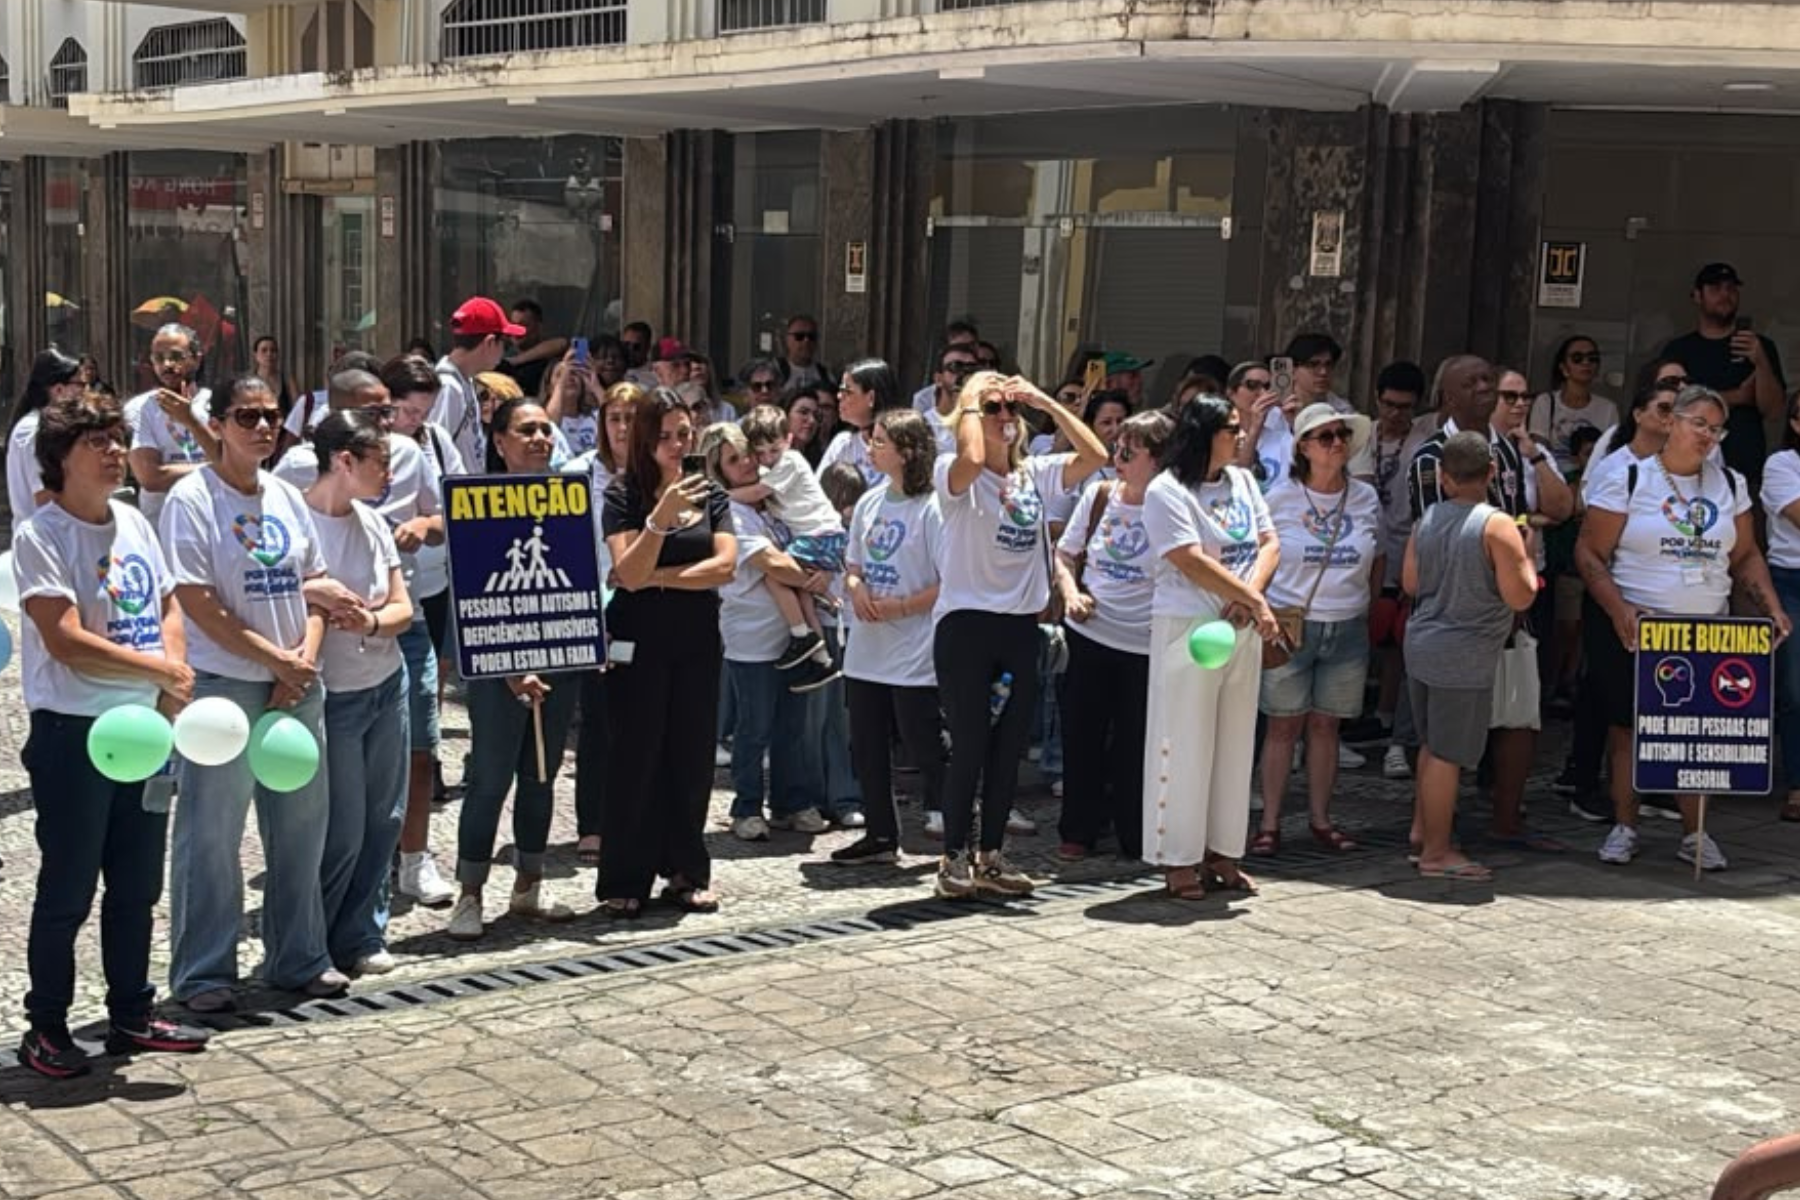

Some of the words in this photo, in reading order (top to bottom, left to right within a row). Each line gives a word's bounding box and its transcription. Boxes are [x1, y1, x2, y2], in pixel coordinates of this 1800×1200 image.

[451, 477, 588, 523] ATENÇÃO
[1661, 537, 1685, 547] POR
[1688, 538, 1721, 549] VDAS
[244, 570, 264, 581] POR
[244, 583, 264, 594] POR
[459, 598, 512, 619] PESSOAS
[513, 595, 540, 615] COM
[541, 592, 590, 613] AUTISMO
[590, 591, 598, 610] E
[107, 619, 133, 632] POR
[463, 621, 541, 647] DEFICIÊNCIAS
[541, 616, 599, 641] INVISÍVEIS
[1640, 621, 1692, 651] EVITE
[1696, 623, 1771, 654] BUZINAS
[472, 652, 512, 674] PODEM
[514, 649, 548, 670] ESTAR
[549, 647, 565, 666] NA
[566, 644, 596, 665] FAIXA
[1638, 715, 1666, 735] PODE
[1667, 716, 1699, 736] HAVER
[1701, 717, 1745, 737] PESSOAS
[1747, 717, 1769, 737] COM
[1638, 742, 1687, 762] AUTISMO
[1688, 743, 1694, 762] E
[1677, 769, 1731, 789] SENSORIAL
